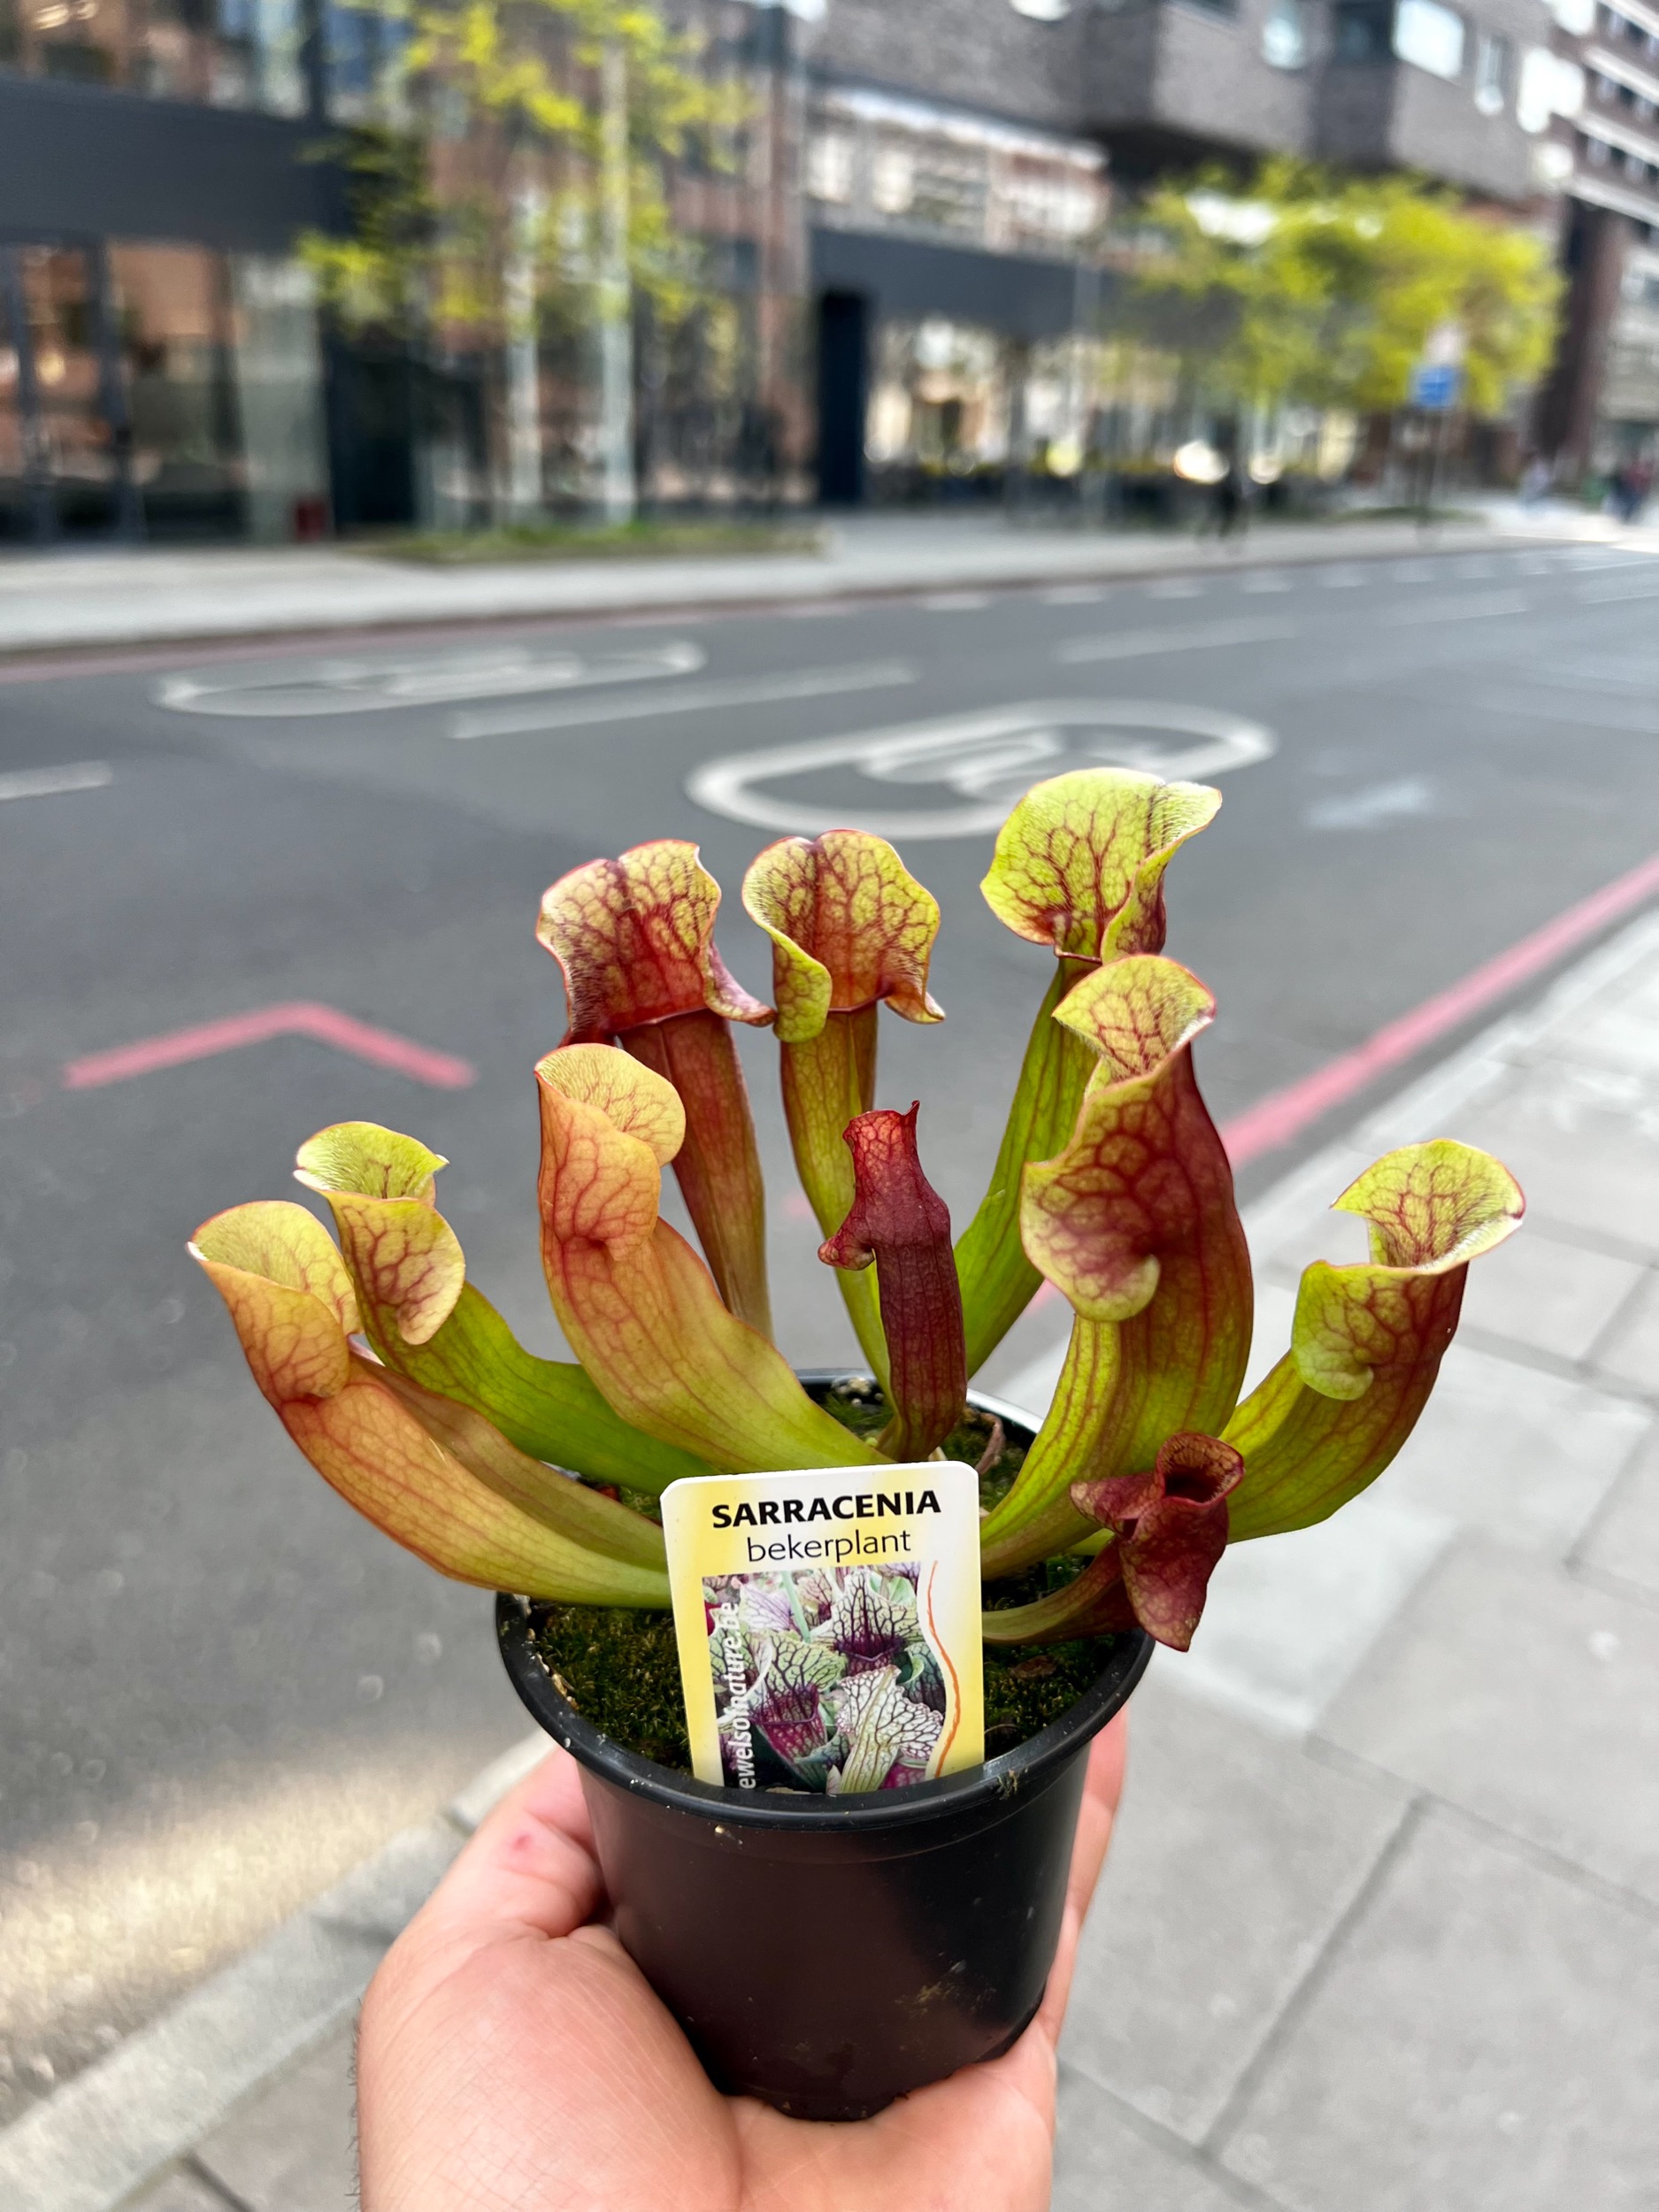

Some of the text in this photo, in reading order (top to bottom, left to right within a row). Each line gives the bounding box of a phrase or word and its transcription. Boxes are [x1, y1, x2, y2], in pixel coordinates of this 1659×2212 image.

[711, 1490, 941, 1528] SARRACENIA
[747, 1529, 911, 1563] bekerplant
[721, 1601, 757, 1790] ewelsofnature.be
